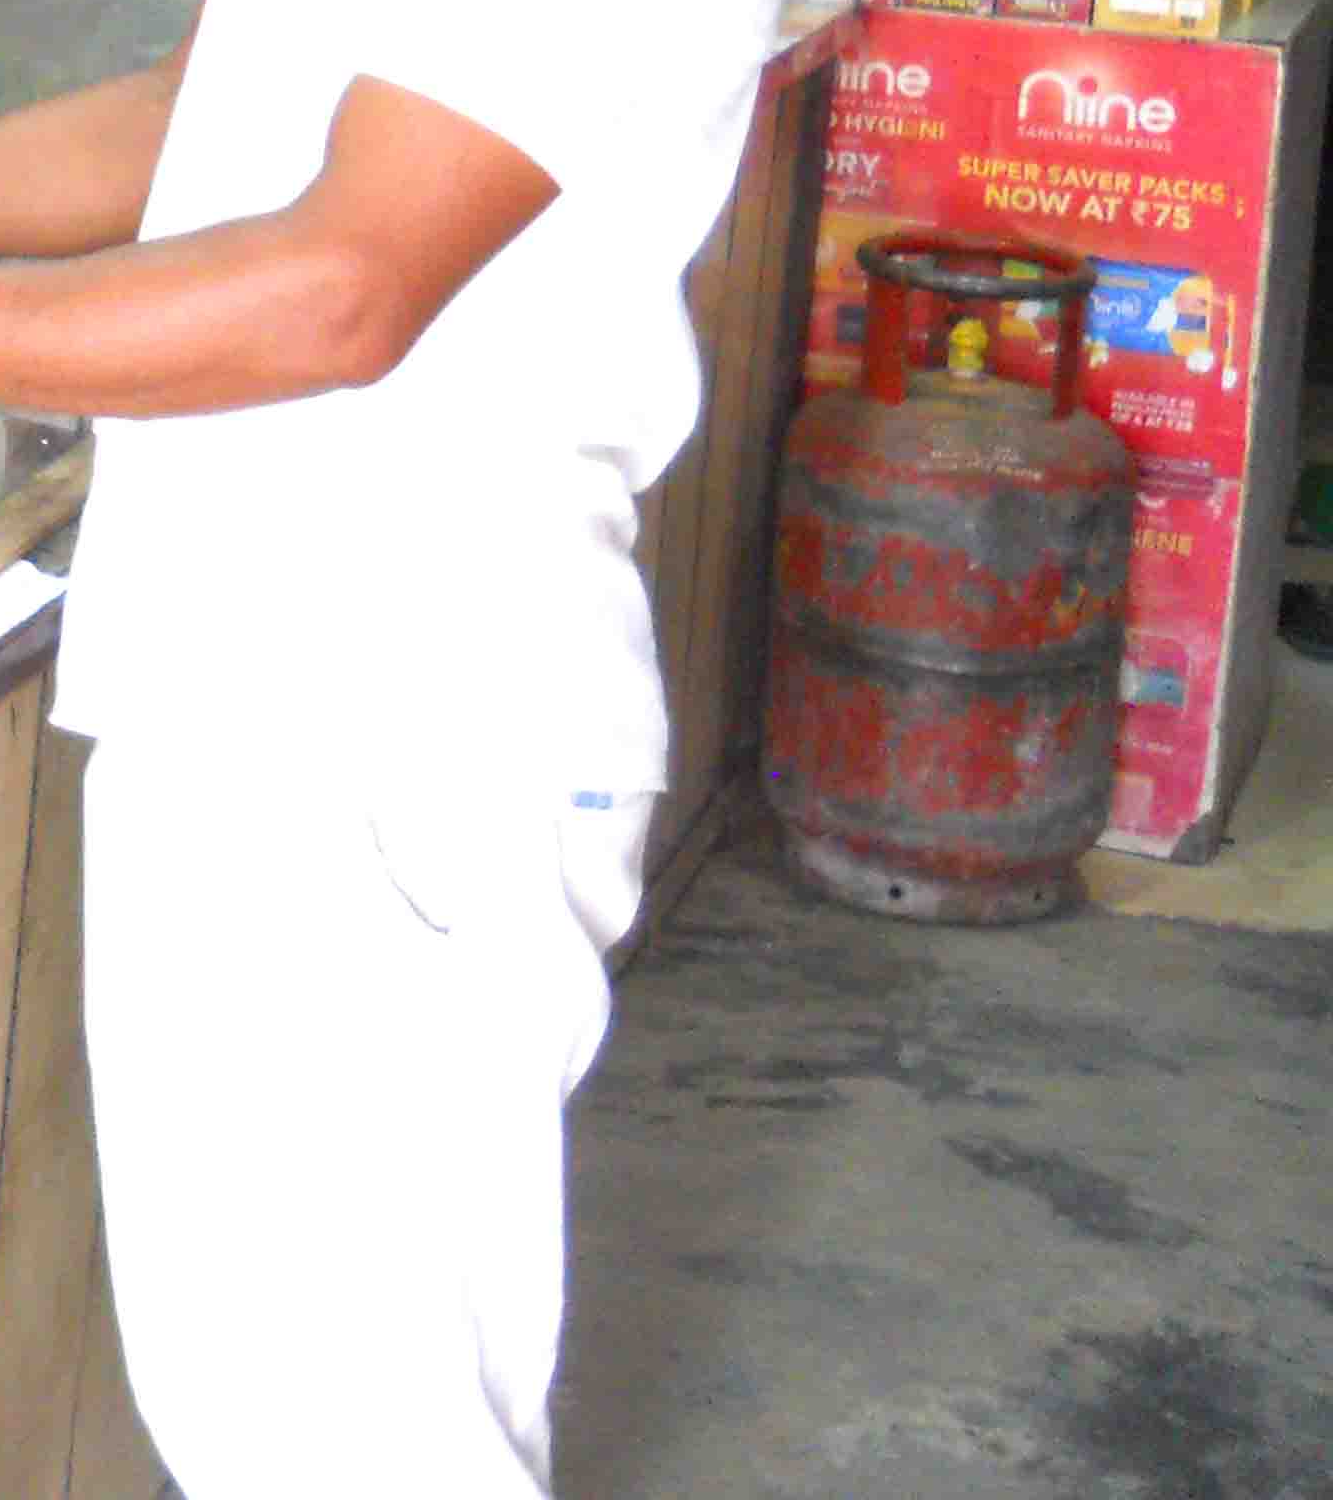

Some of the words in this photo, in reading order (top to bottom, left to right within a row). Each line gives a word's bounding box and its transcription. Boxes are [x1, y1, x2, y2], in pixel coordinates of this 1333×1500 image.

[836, 60, 931, 100] iine
[958, 155, 1041, 181] SUPER
[1047, 163, 1131, 194] SAVER
[1139, 174, 1226, 205] PACKS
[985, 183, 1072, 216] NOW
[1081, 195, 1123, 223] AT
